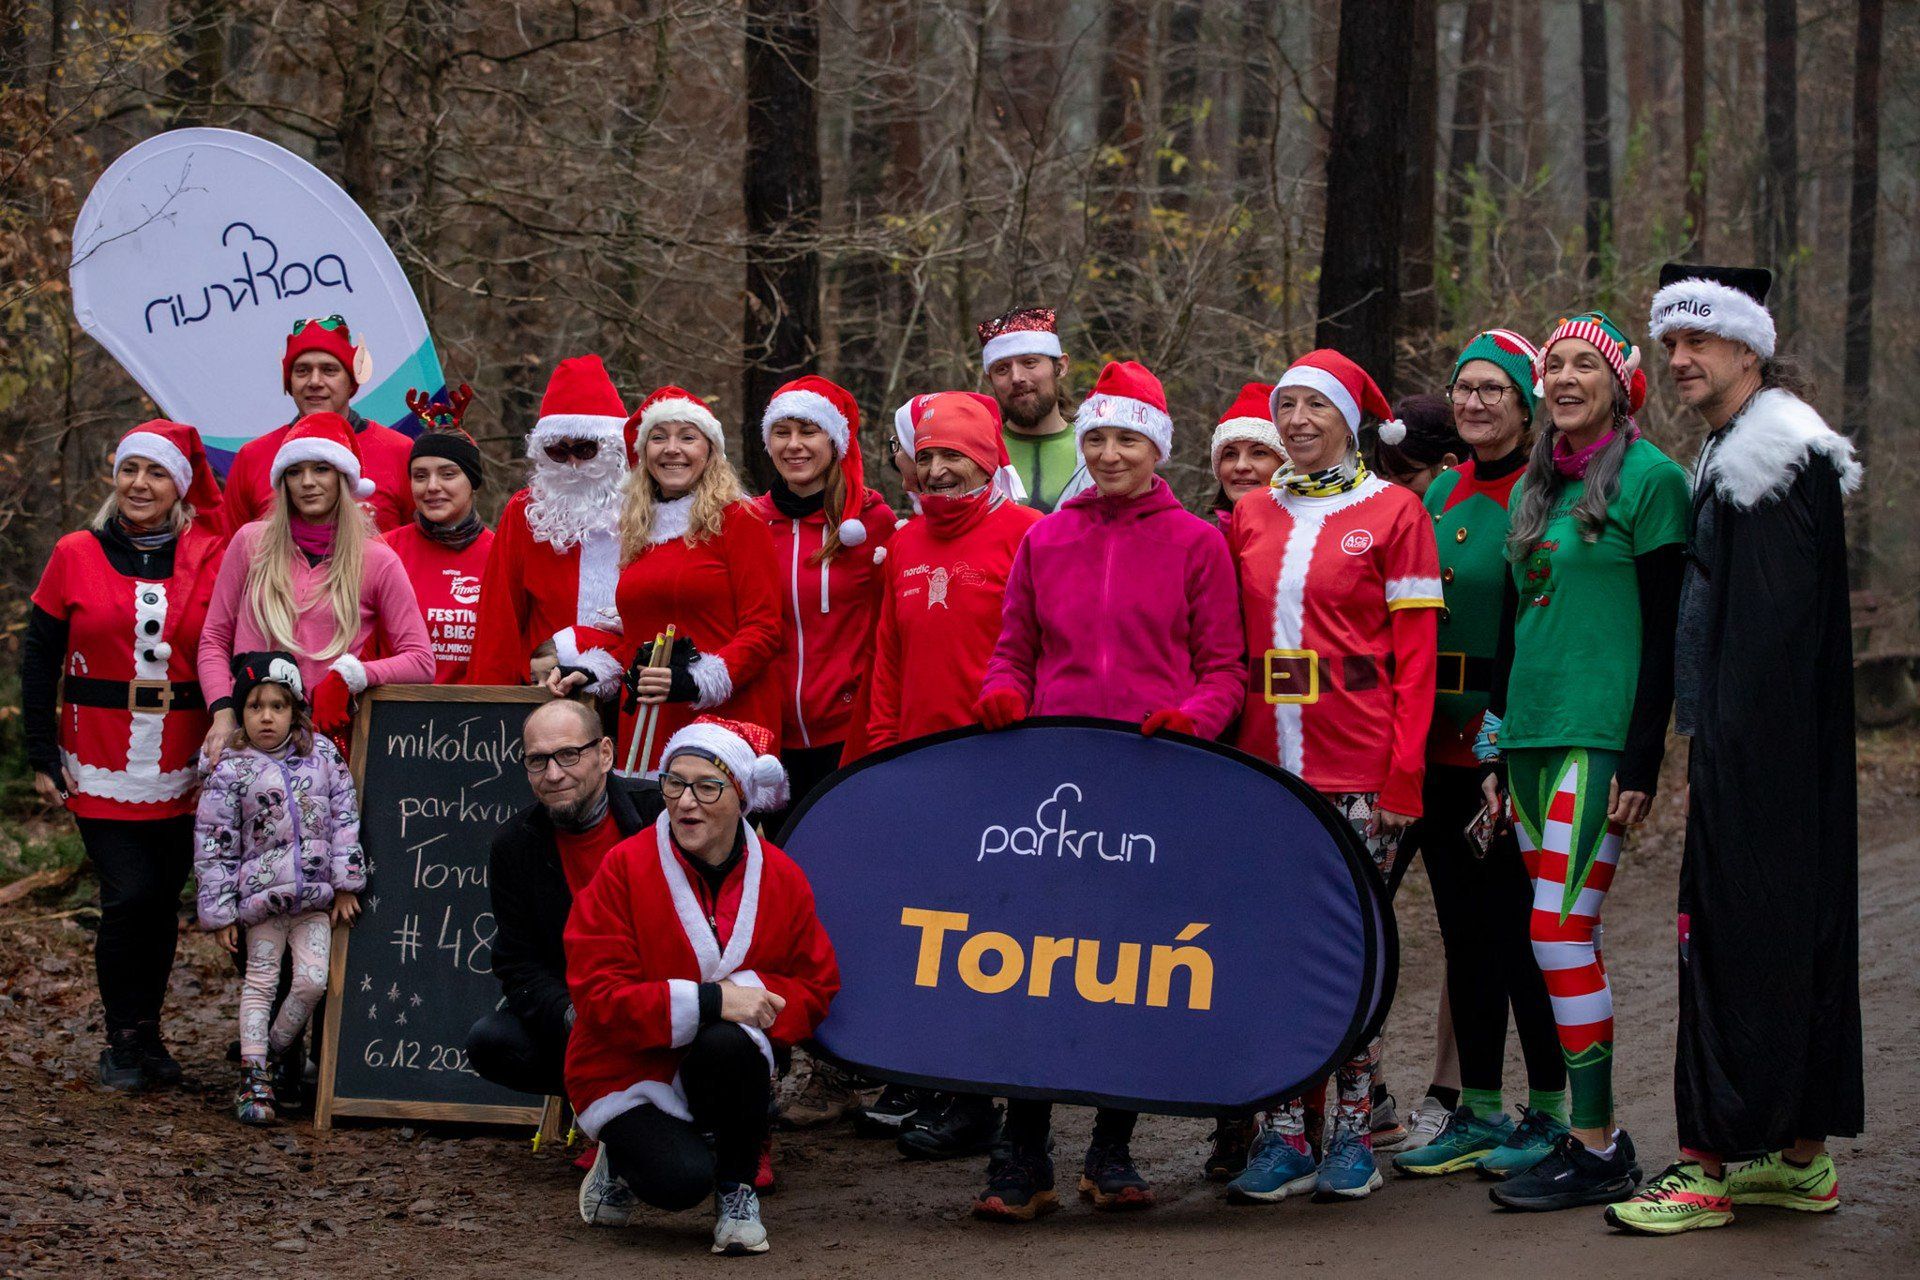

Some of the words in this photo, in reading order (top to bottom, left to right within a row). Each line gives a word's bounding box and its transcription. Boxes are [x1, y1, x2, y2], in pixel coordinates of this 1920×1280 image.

[1131, 402, 1148, 425] HO
[399, 787, 517, 838] parkru
[977, 783, 1156, 863] parkrun
[901, 907, 1214, 1011] Toruń
[427, 1045, 480, 1077] 202
[1640, 1196, 1713, 1214] MERRELL
